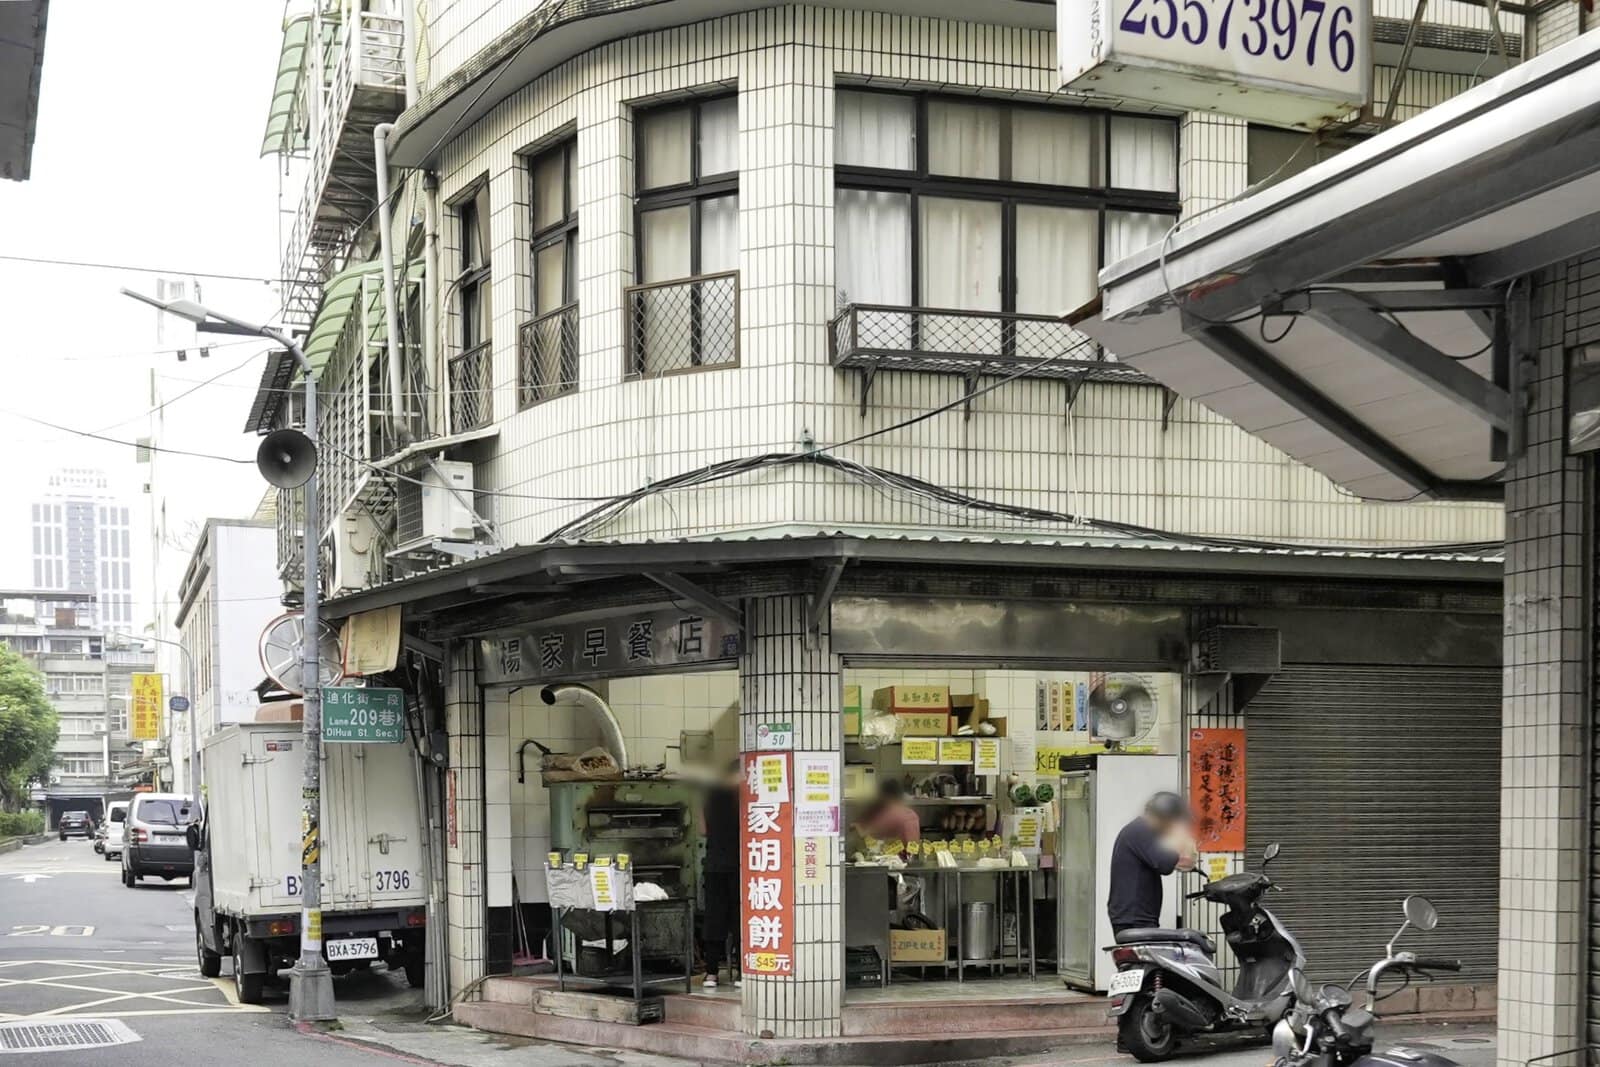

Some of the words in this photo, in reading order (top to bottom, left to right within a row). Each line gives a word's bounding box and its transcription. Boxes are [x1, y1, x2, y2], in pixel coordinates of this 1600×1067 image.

[501, 615, 704, 675] 楊家早餐店
[326, 690, 399, 706] 迪化街一段
[329, 717, 349, 726] Lane
[350, 708, 396, 726] 209巷
[771, 734, 785, 746] 50
[375, 869, 410, 891] 3796
